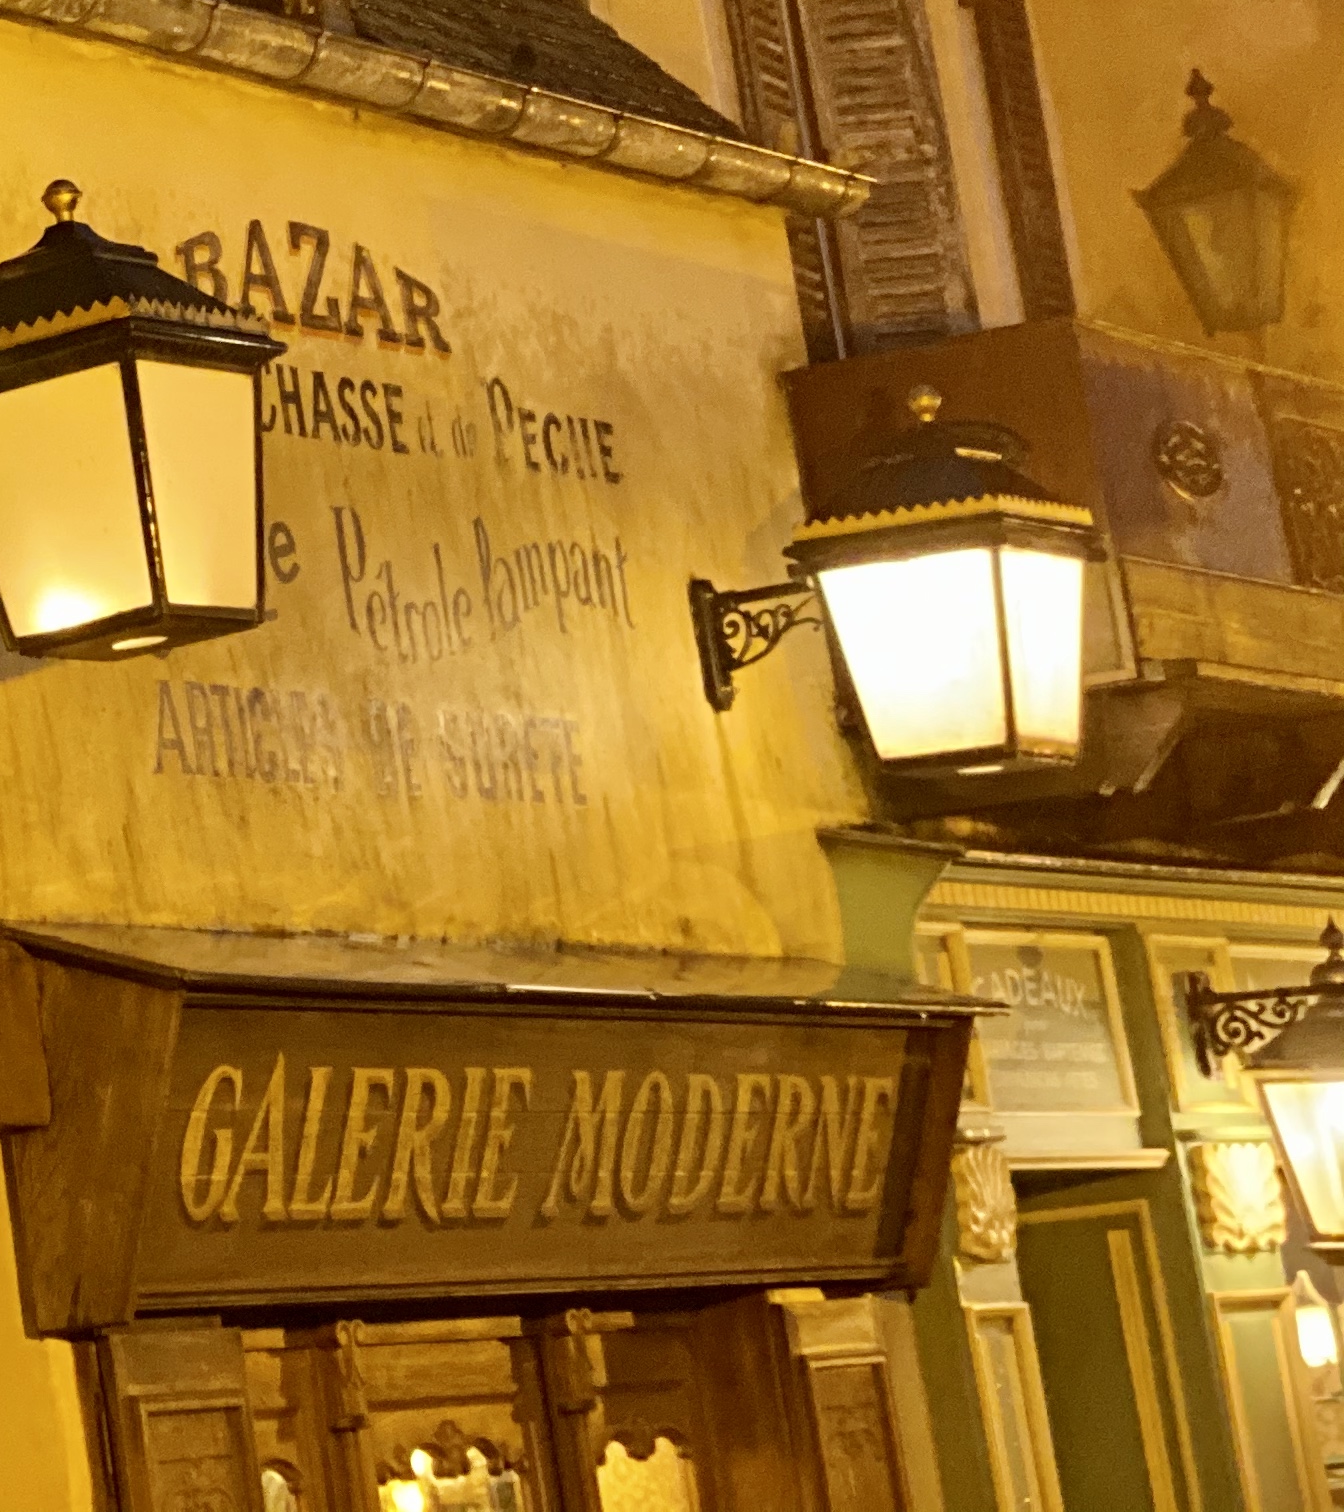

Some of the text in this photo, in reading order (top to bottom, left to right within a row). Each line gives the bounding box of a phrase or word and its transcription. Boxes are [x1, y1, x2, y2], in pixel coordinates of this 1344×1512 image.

[175, 219, 451, 356] BAZAR
[262, 360, 410, 455] CHASSE
[180, 1051, 895, 1224] GALERIE MODERNE
